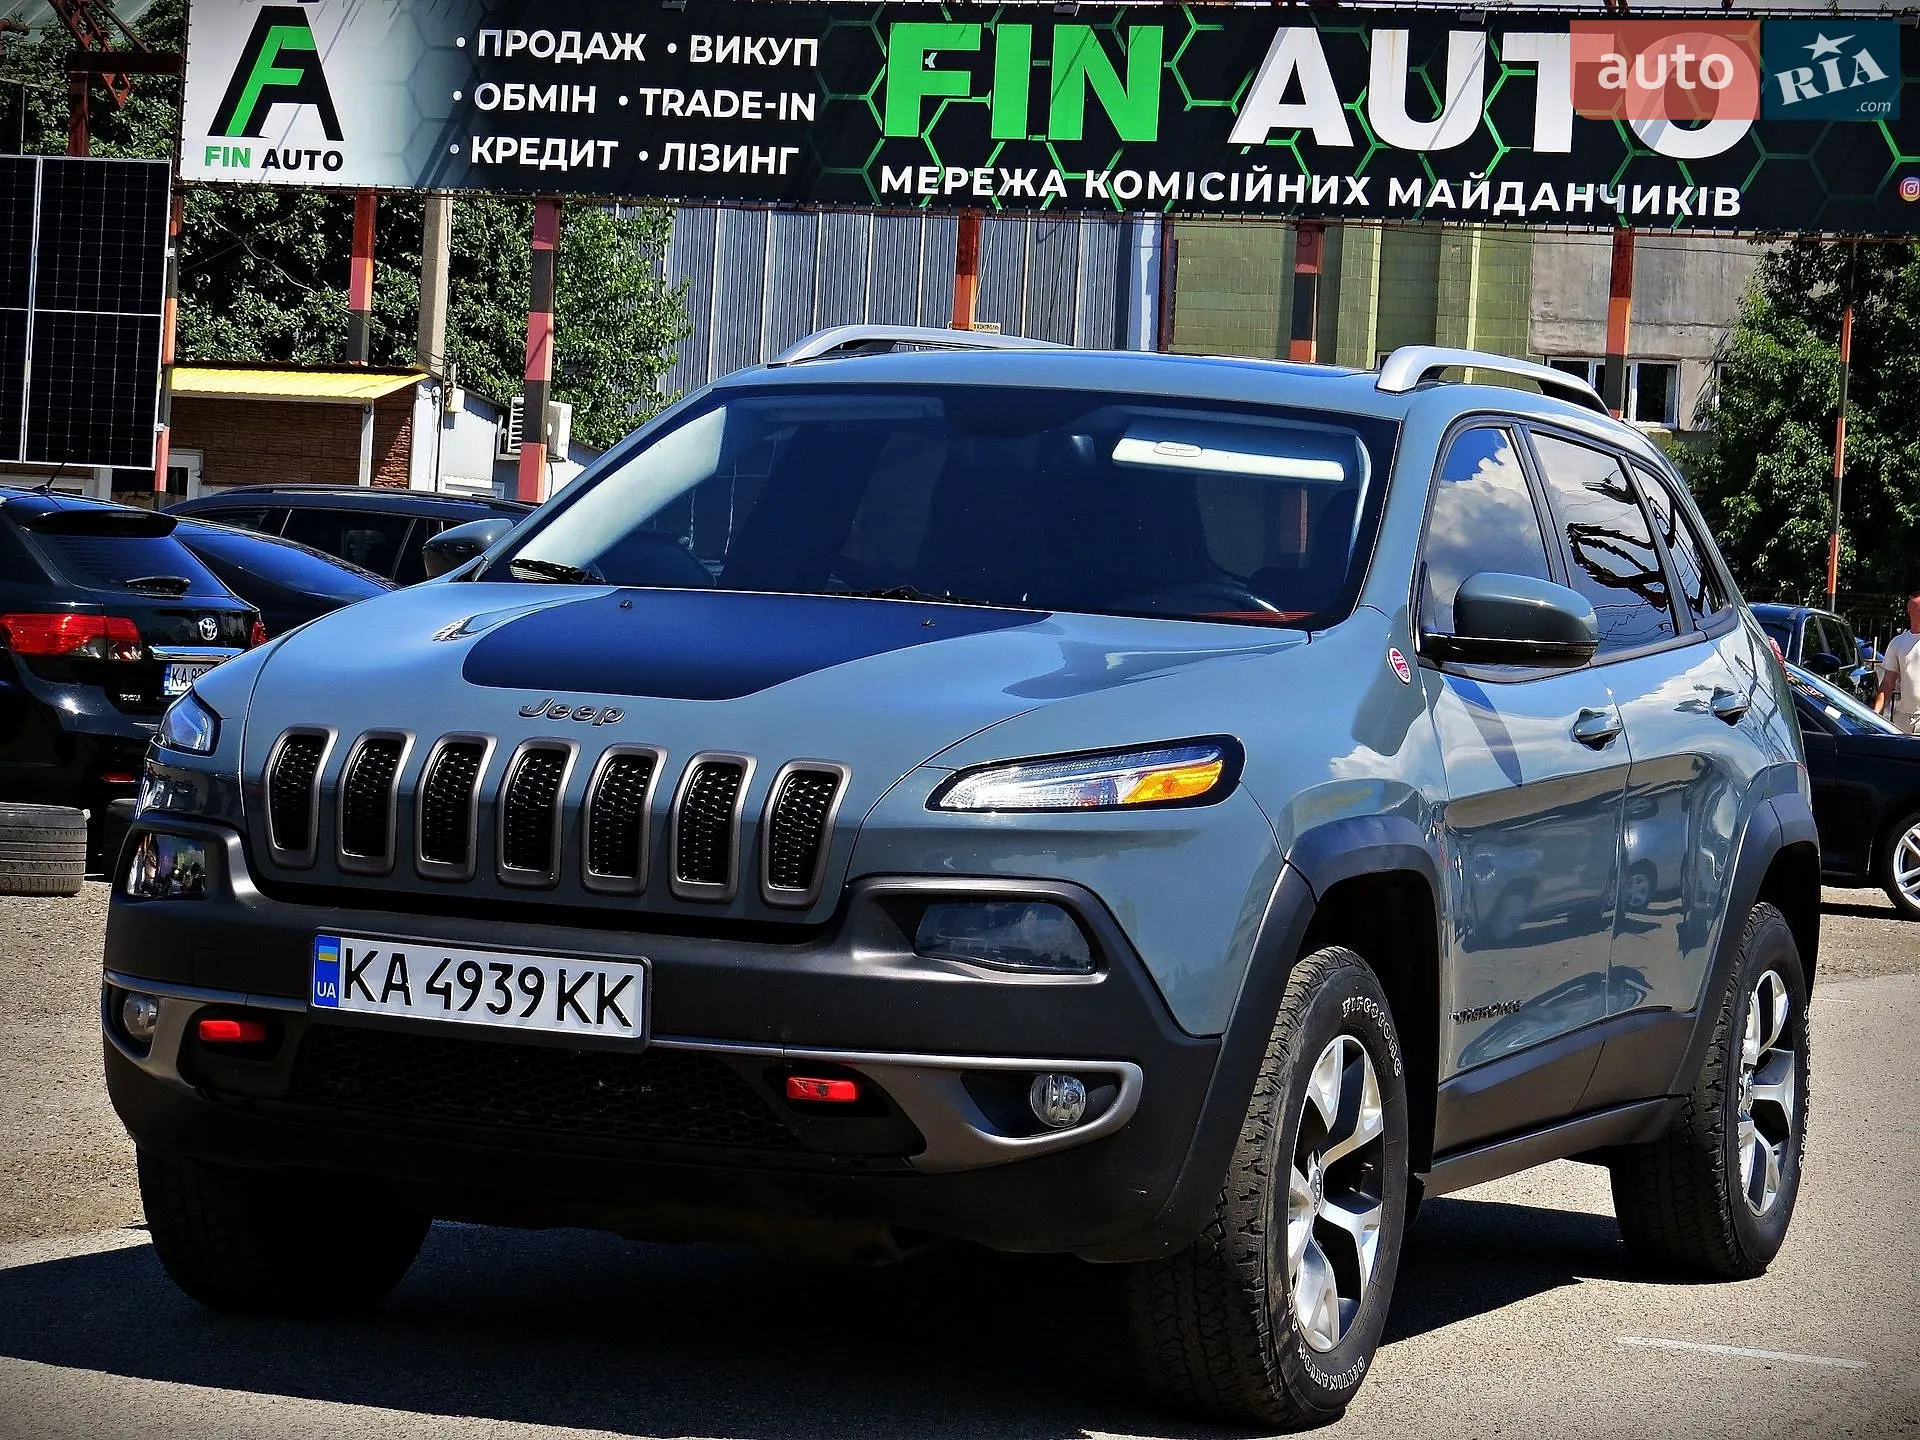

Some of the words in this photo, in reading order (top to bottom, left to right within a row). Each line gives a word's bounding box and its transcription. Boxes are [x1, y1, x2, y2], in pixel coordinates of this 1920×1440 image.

[477, 29, 647, 62] ПРОДАЖ
[690, 35, 819, 67] ВИКУП
[474, 81, 597, 114] ОБМІН
[639, 87, 817, 122] TRADE-IN
[884, 22, 1165, 142] FIN
[1227, 26, 1760, 160] AUTO
[204, 145, 252, 169] FIN
[260, 148, 344, 172] AUTO
[470, 135, 619, 169] КРЕДИТ
[658, 142, 800, 175] ЛІЗИНГ
[880, 165, 1068, 199] МЕРЕЖА
[1085, 165, 1371, 207] КОМІСІЙНИХ
[1388, 172, 1742, 218] МАЙДАНЧИКІВ
[171, 667, 188, 687] KA
[518, 697, 626, 727] Jeep
[316, 980, 337, 999] UA
[343, 946, 414, 1007] KA
[424, 957, 547, 1019] 4939
[556, 968, 635, 1028] KK
